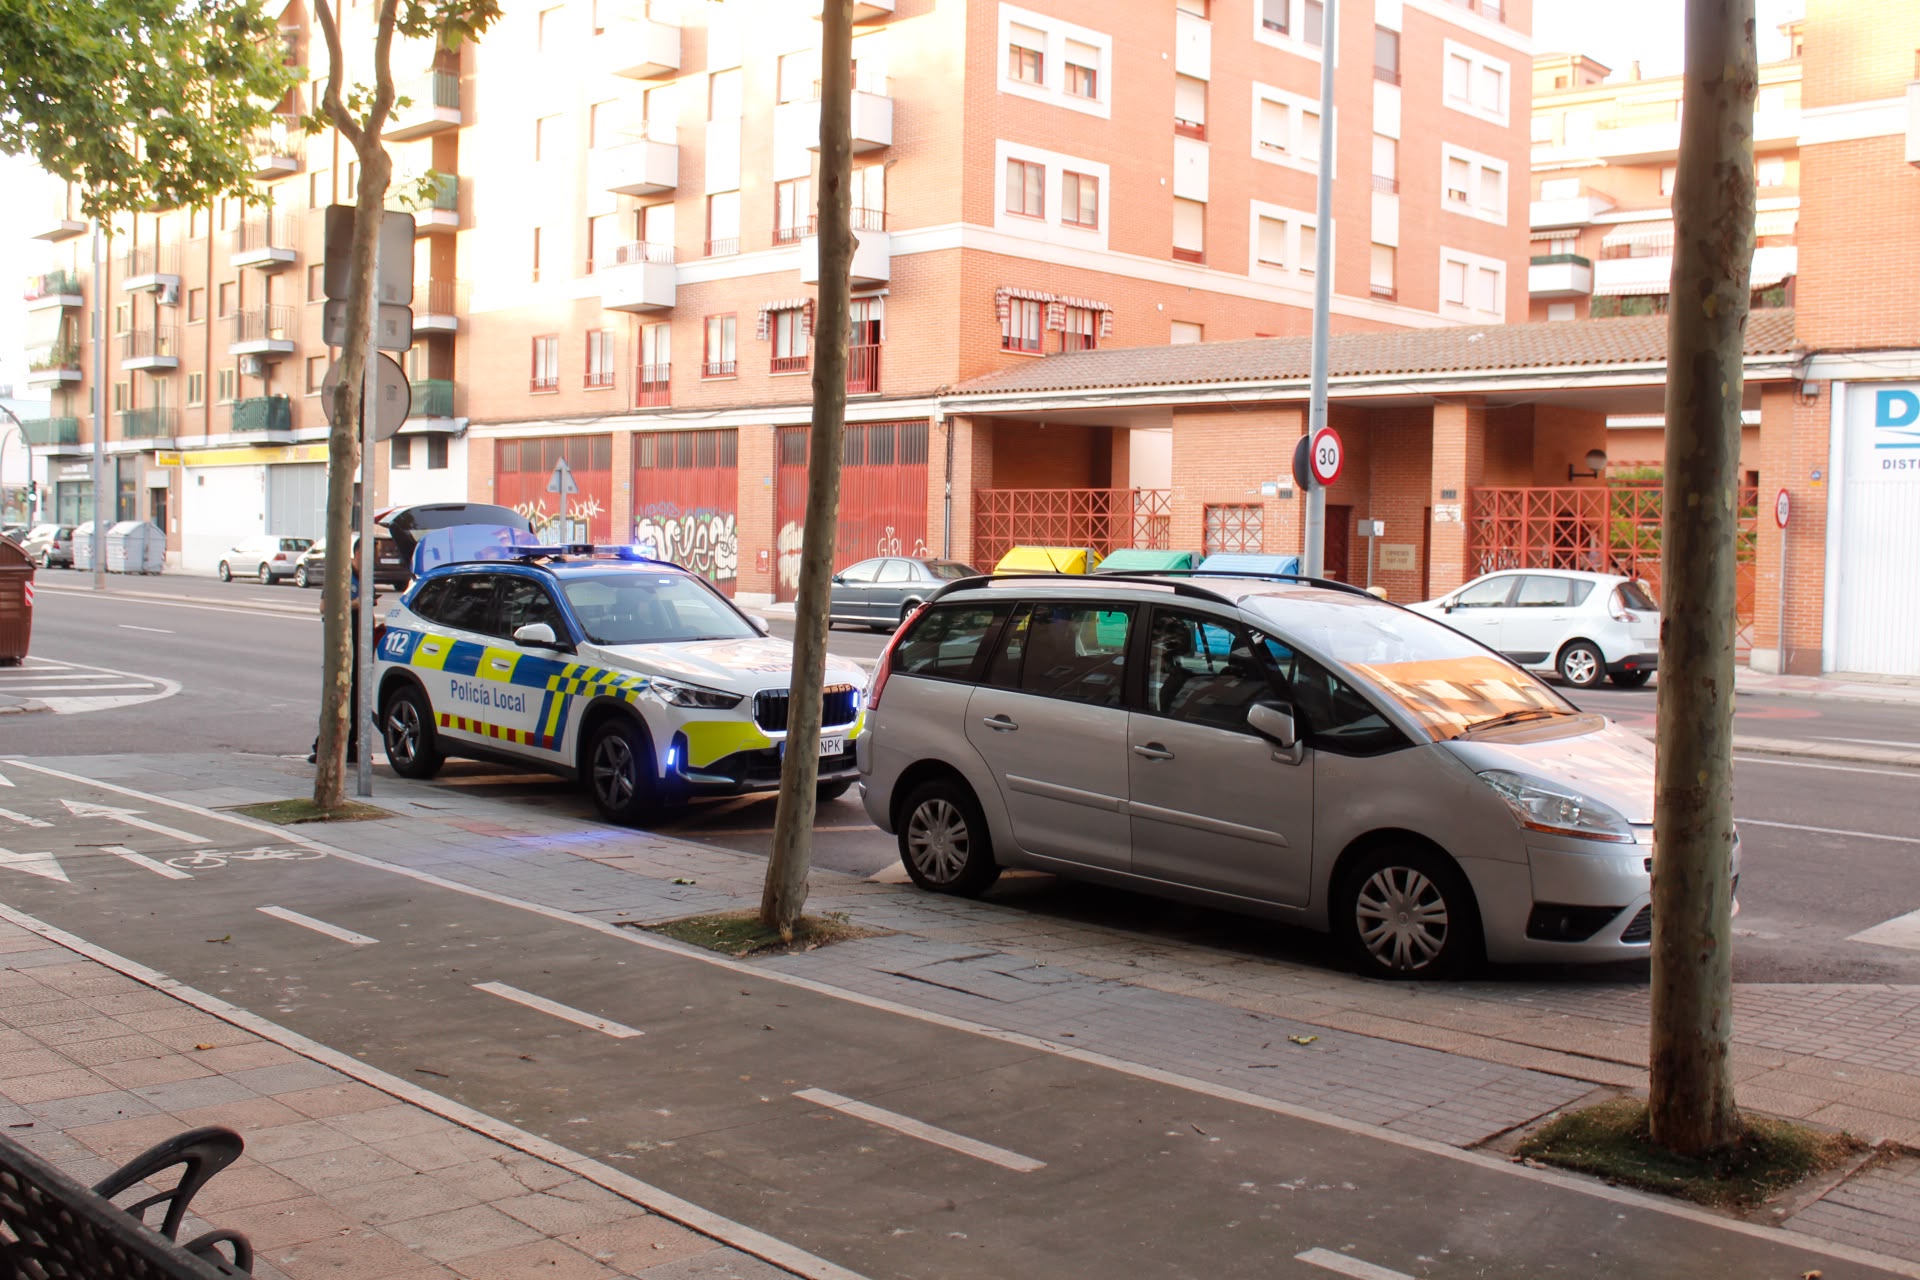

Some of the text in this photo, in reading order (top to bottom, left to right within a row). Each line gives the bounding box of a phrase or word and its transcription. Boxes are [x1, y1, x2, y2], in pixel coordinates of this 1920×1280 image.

[1319, 448, 1336, 466] 30
[1780, 502, 1788, 515] 30
[385, 632, 409, 653] 112
[451, 680, 526, 713] Policía Local
[820, 739, 841, 754] NPK
